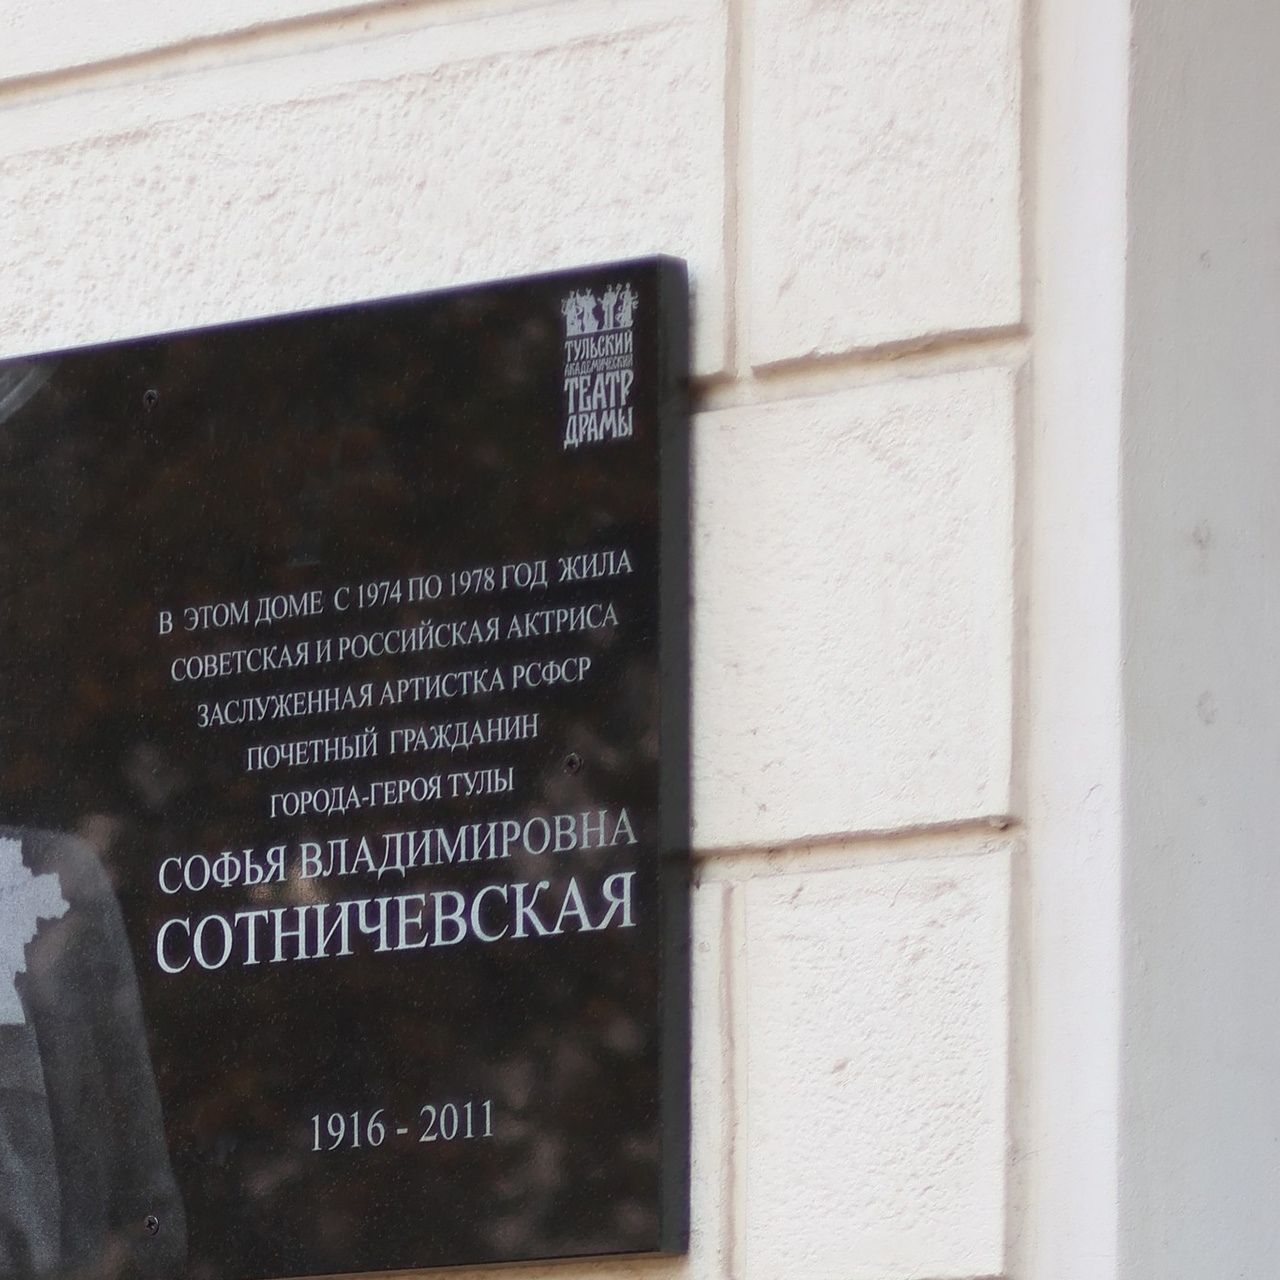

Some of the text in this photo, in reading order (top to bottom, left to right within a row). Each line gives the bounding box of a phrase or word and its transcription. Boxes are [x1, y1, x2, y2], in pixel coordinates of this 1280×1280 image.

[564, 330, 633, 362] ТУЛЬСКИЙ
[564, 353, 633, 377] АКАДЕМИЧЕСКИЙ
[564, 369, 634, 414] ТЕАТР
[564, 407, 633, 450] ДРАМЫ
[159, 549, 633, 635] В ЭТОМ ДОМЕ С 1974 ПО 1978 ГОД ЖИЛА
[171, 602, 619, 681] СОВЕТСКАЯ И РОССИЙСКАЯ АКТРИСА
[197, 656, 591, 727] ЗАСЛУЖЕННАЯ АРТИСТКА РСФСР
[247, 713, 539, 771] ПОЧЕТНЫЙ ГРАЖДАНИН
[270, 767, 515, 818] ГОРОДА-ГЕРОЯ ТУЛЫ
[159, 807, 638, 894] СОФЬЯ ВЛАДИМИРОВНА
[156, 871, 637, 973] СОТНИЧЕВСКАЯ
[311, 1109, 385, 1150] 1916
[419, 1100, 493, 1141] 2011
